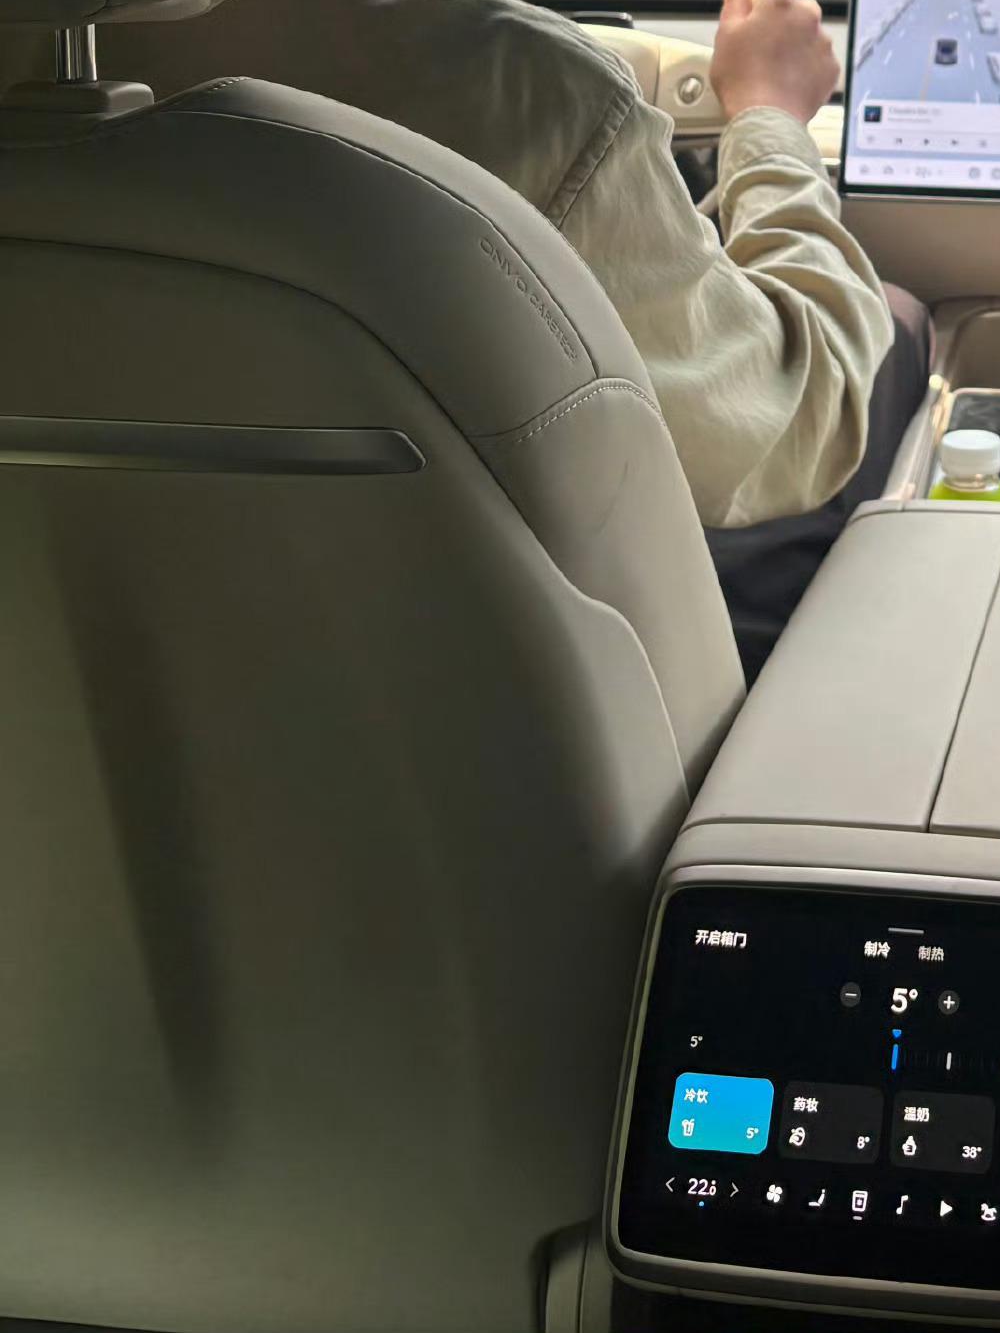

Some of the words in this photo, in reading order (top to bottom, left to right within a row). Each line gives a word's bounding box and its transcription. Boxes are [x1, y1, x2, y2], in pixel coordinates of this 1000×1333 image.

[695, 929, 748, 949] 开启箱门
[864, 940, 891, 958] 制冷
[918, 945, 945, 962] 制热
[890, 987, 919, 1013] 5°
[684, 1088, 709, 1104] 冷饮
[793, 1096, 819, 1113] 药妆
[903, 1106, 930, 1123] 温奶
[962, 1145, 983, 1159] 38°
